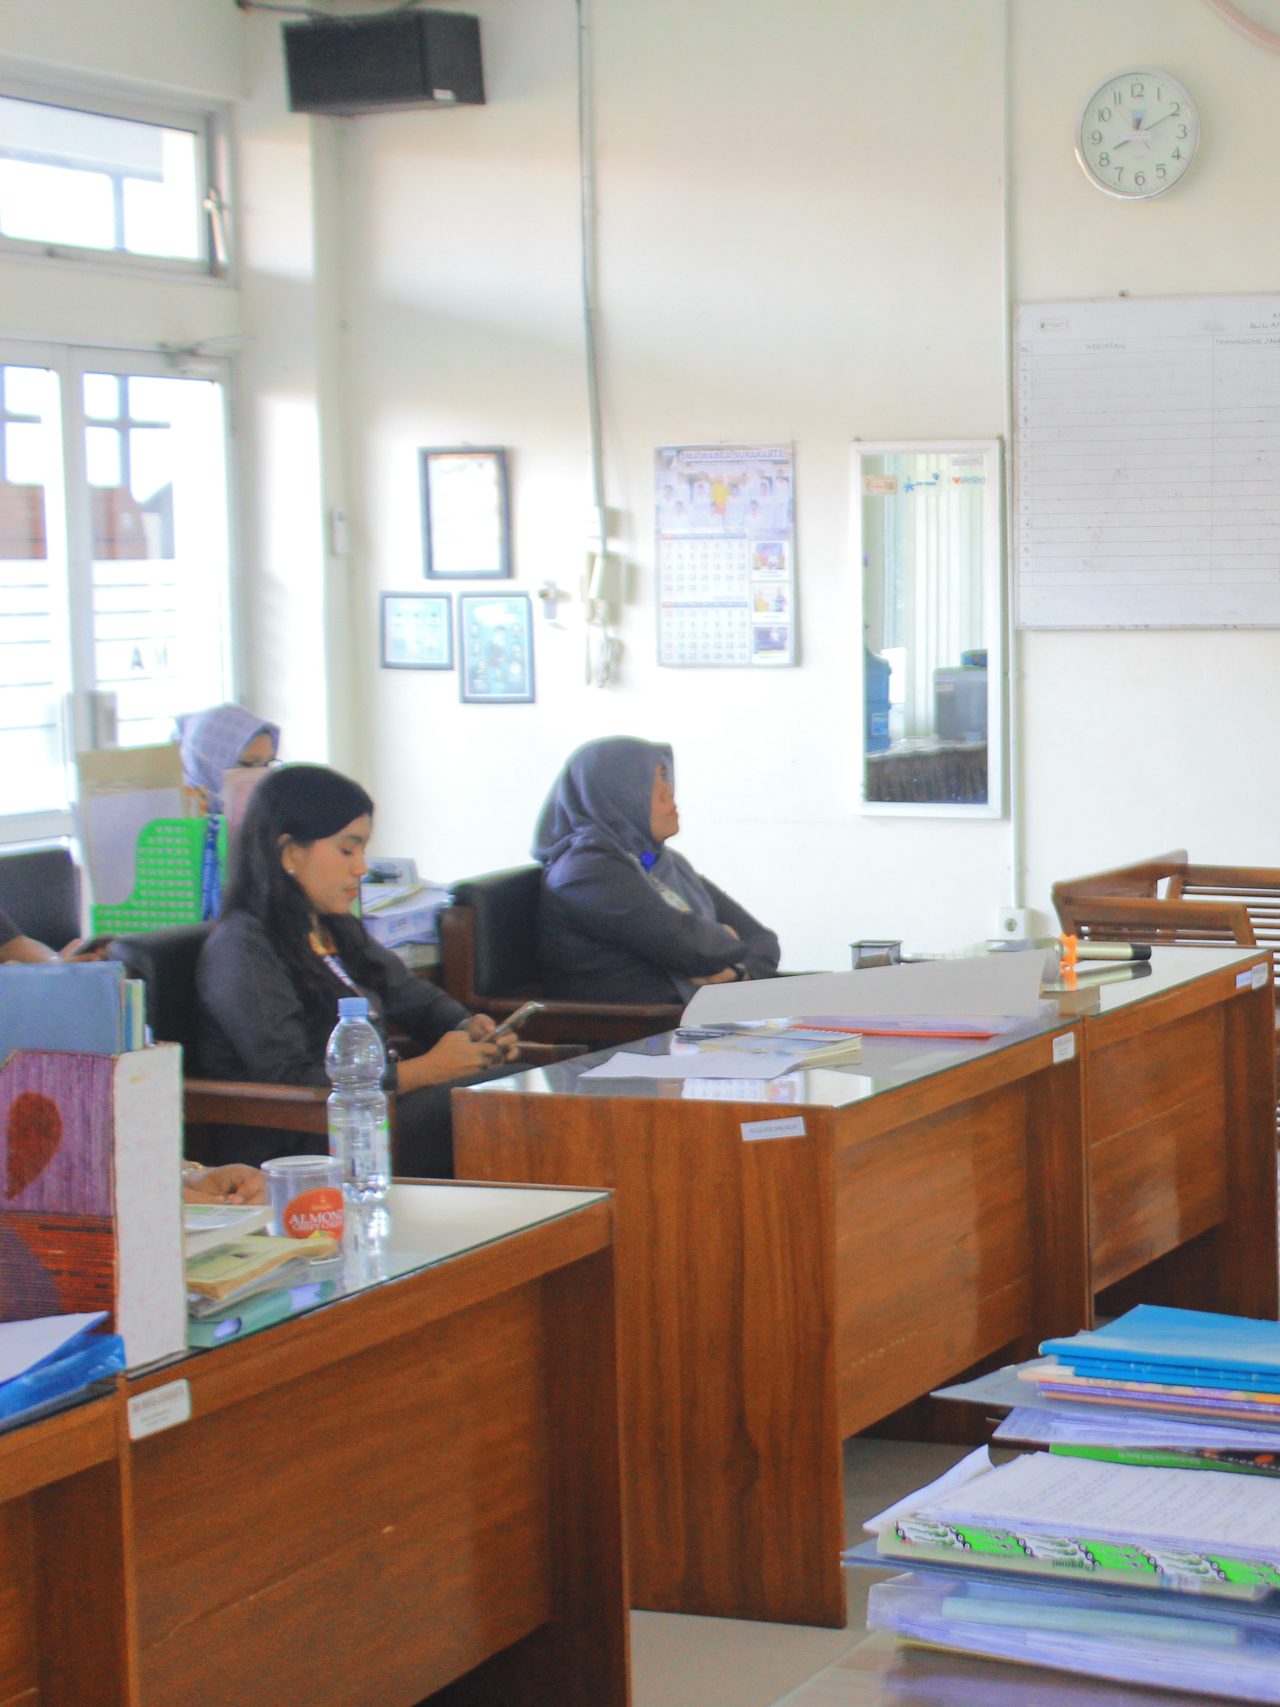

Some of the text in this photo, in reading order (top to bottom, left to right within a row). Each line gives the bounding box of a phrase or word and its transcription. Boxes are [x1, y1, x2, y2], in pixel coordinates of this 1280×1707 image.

[1130, 82, 1144, 98] 12
[1113, 91, 1122, 105] 11
[1098, 107, 1112, 122] 10
[1169, 101, 1180, 117] 2
[1091, 130, 1103, 145] 9
[1176, 124, 1188, 139] 3
[1098, 151, 1110, 167] 8
[1171, 146, 1182, 161] 4
[1113, 166, 1124, 182] 7
[1134, 171, 1146, 186] 6
[1155, 163, 1167, 179] 5
[289, 1209, 343, 1225] ALMON
